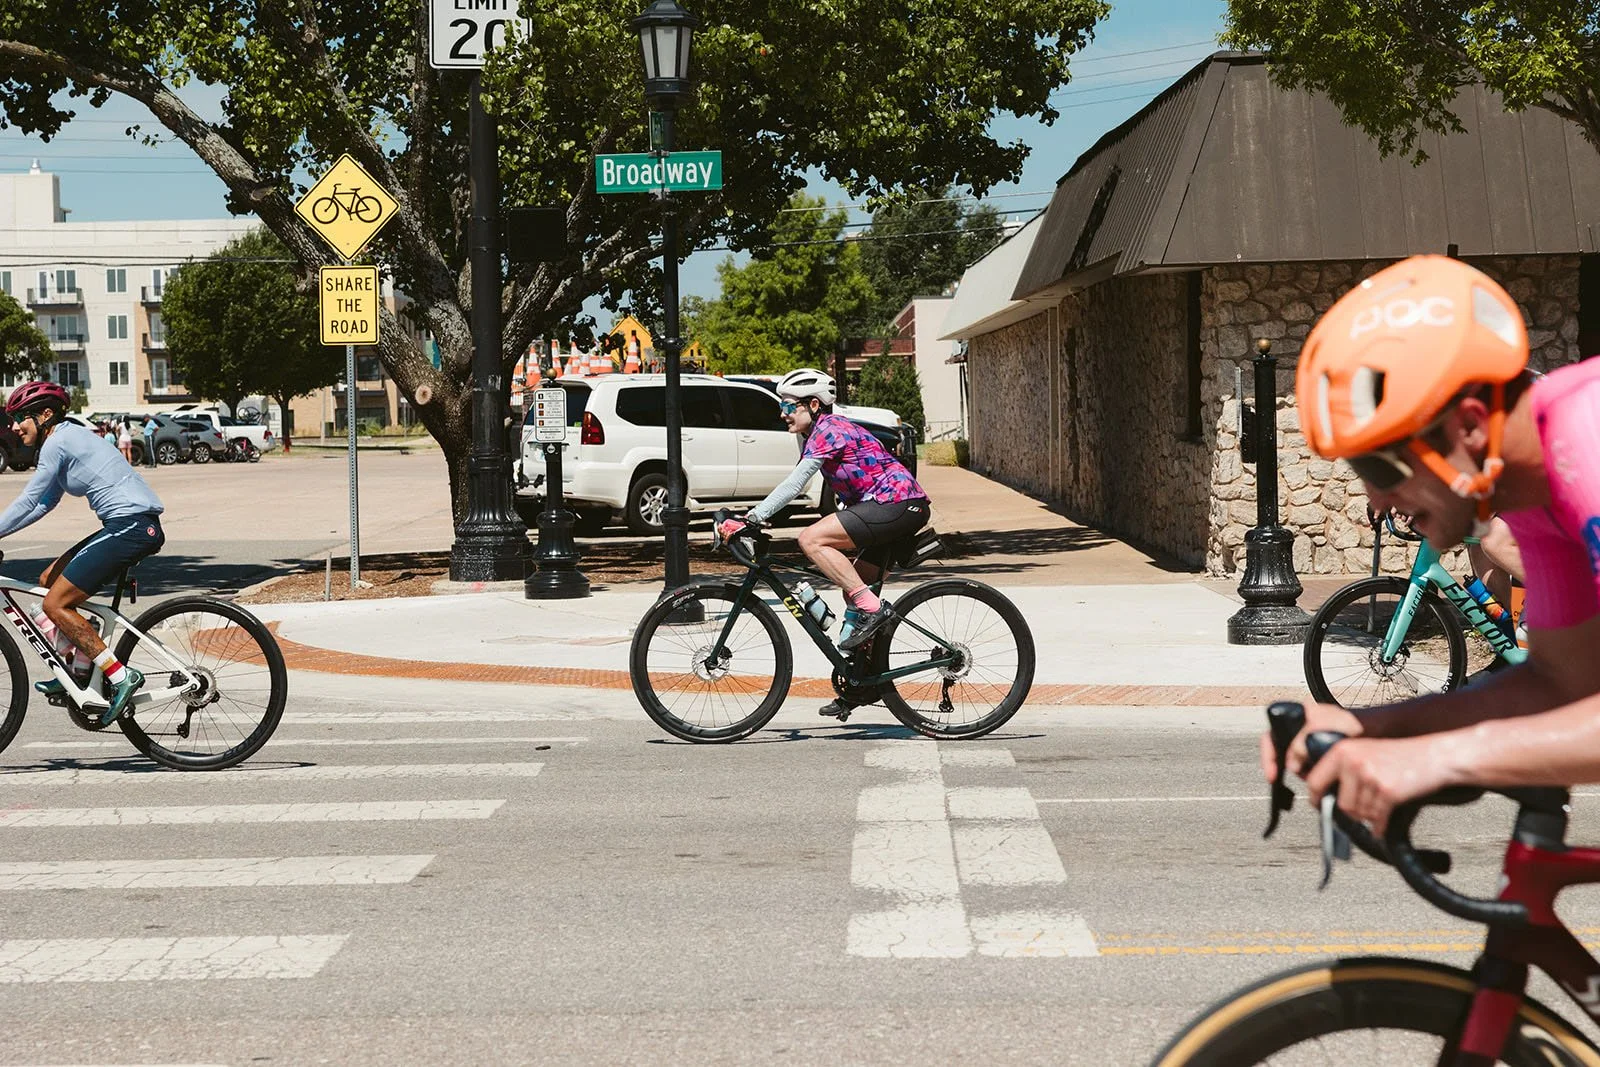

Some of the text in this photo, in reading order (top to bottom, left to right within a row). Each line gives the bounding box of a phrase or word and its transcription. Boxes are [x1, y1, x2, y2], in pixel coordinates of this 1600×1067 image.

[602, 158, 713, 188] Broadway
[326, 276, 373, 291] SHARE
[336, 298, 362, 312] THE
[330, 320, 368, 334] ROAD
[1408, 583, 1425, 616] FACTOR
[1442, 583, 1515, 653] FACTOR
[3, 600, 61, 671] TREK
